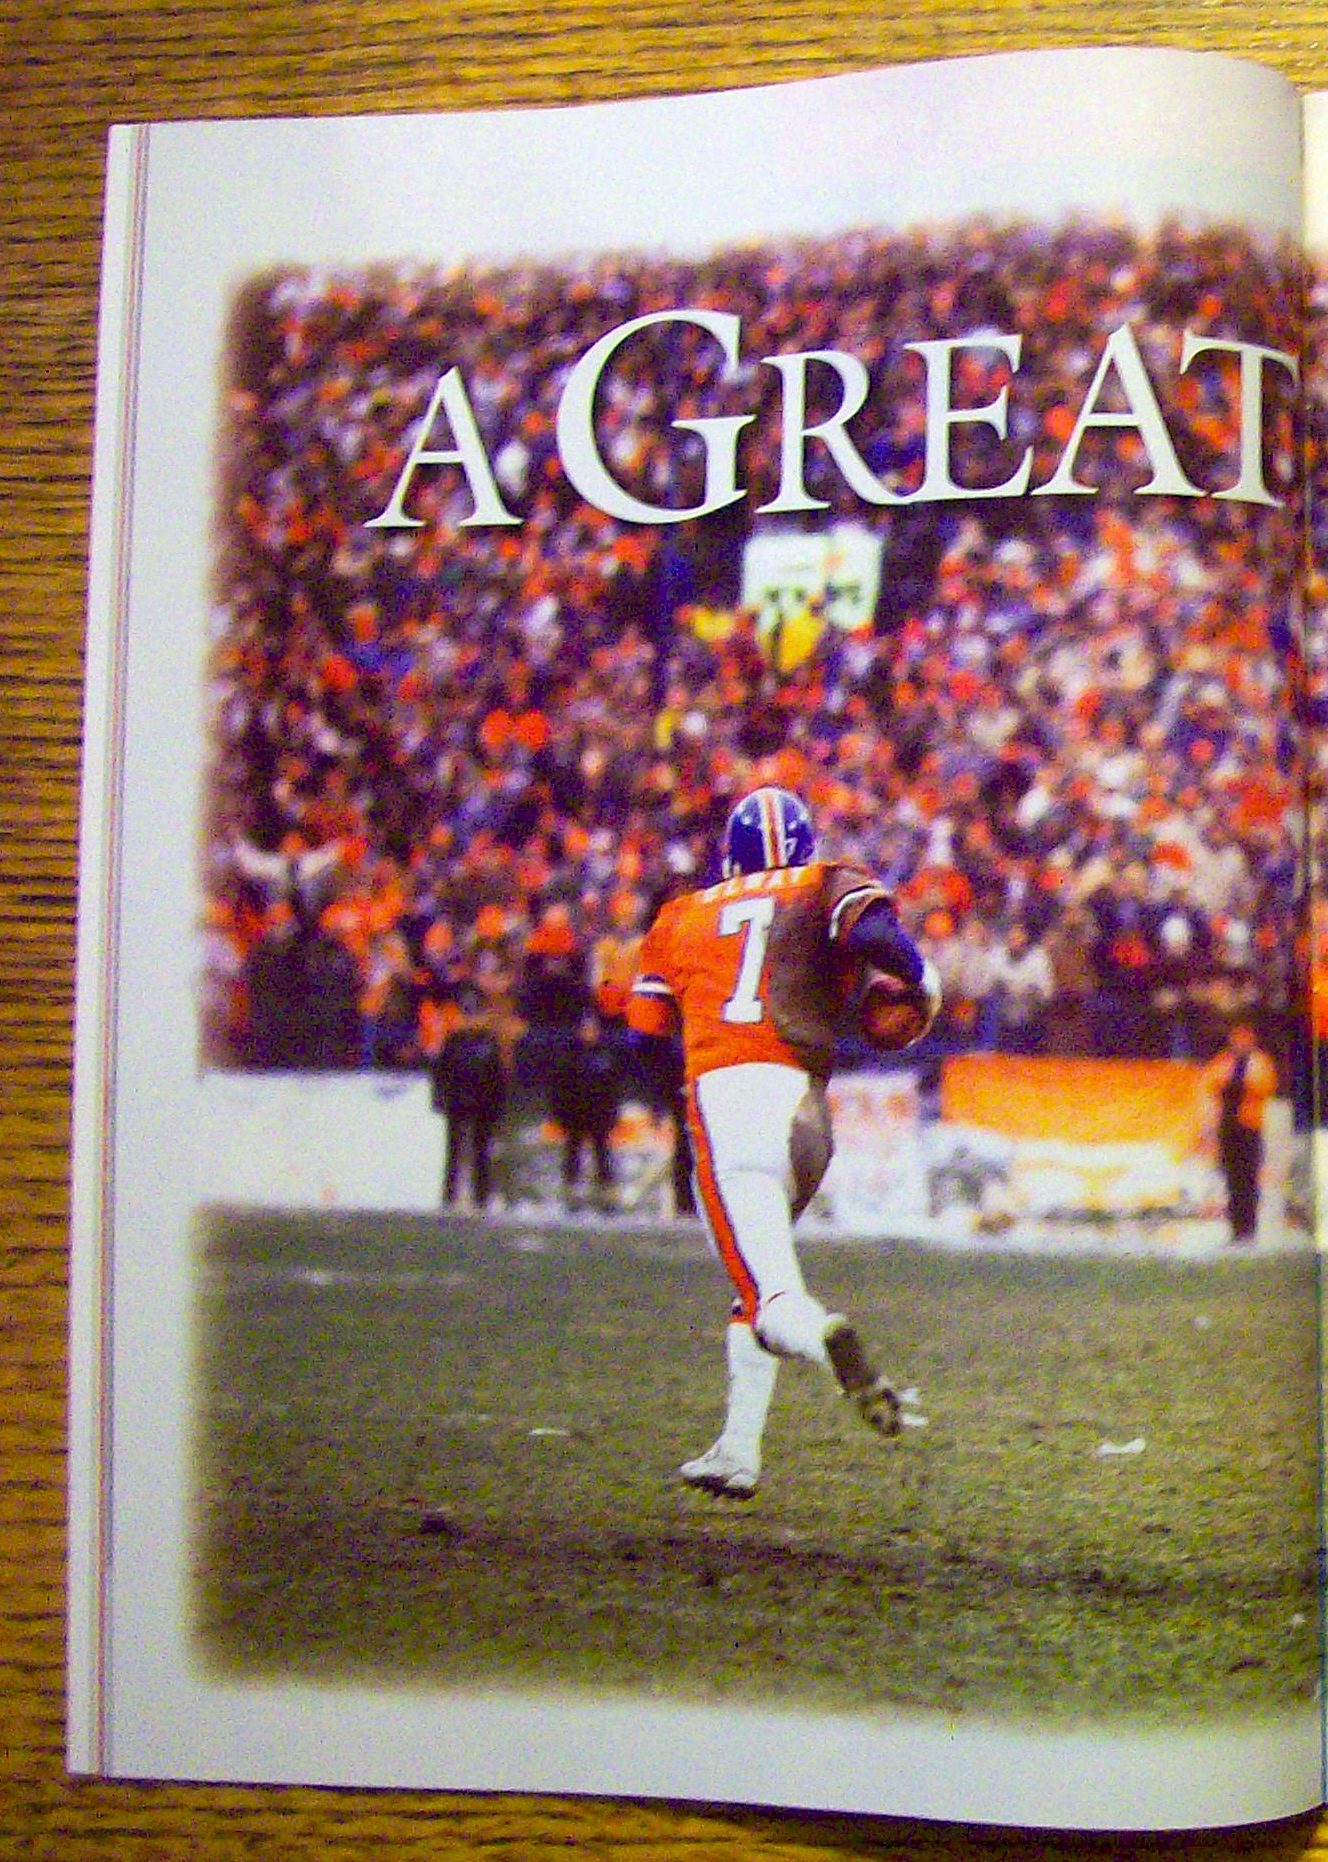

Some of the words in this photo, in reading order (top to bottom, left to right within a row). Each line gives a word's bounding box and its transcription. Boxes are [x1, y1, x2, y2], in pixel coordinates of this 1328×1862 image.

[363, 364, 524, 528] A
[555, 309, 1300, 524] GREAT
[718, 897, 775, 1023] 7
